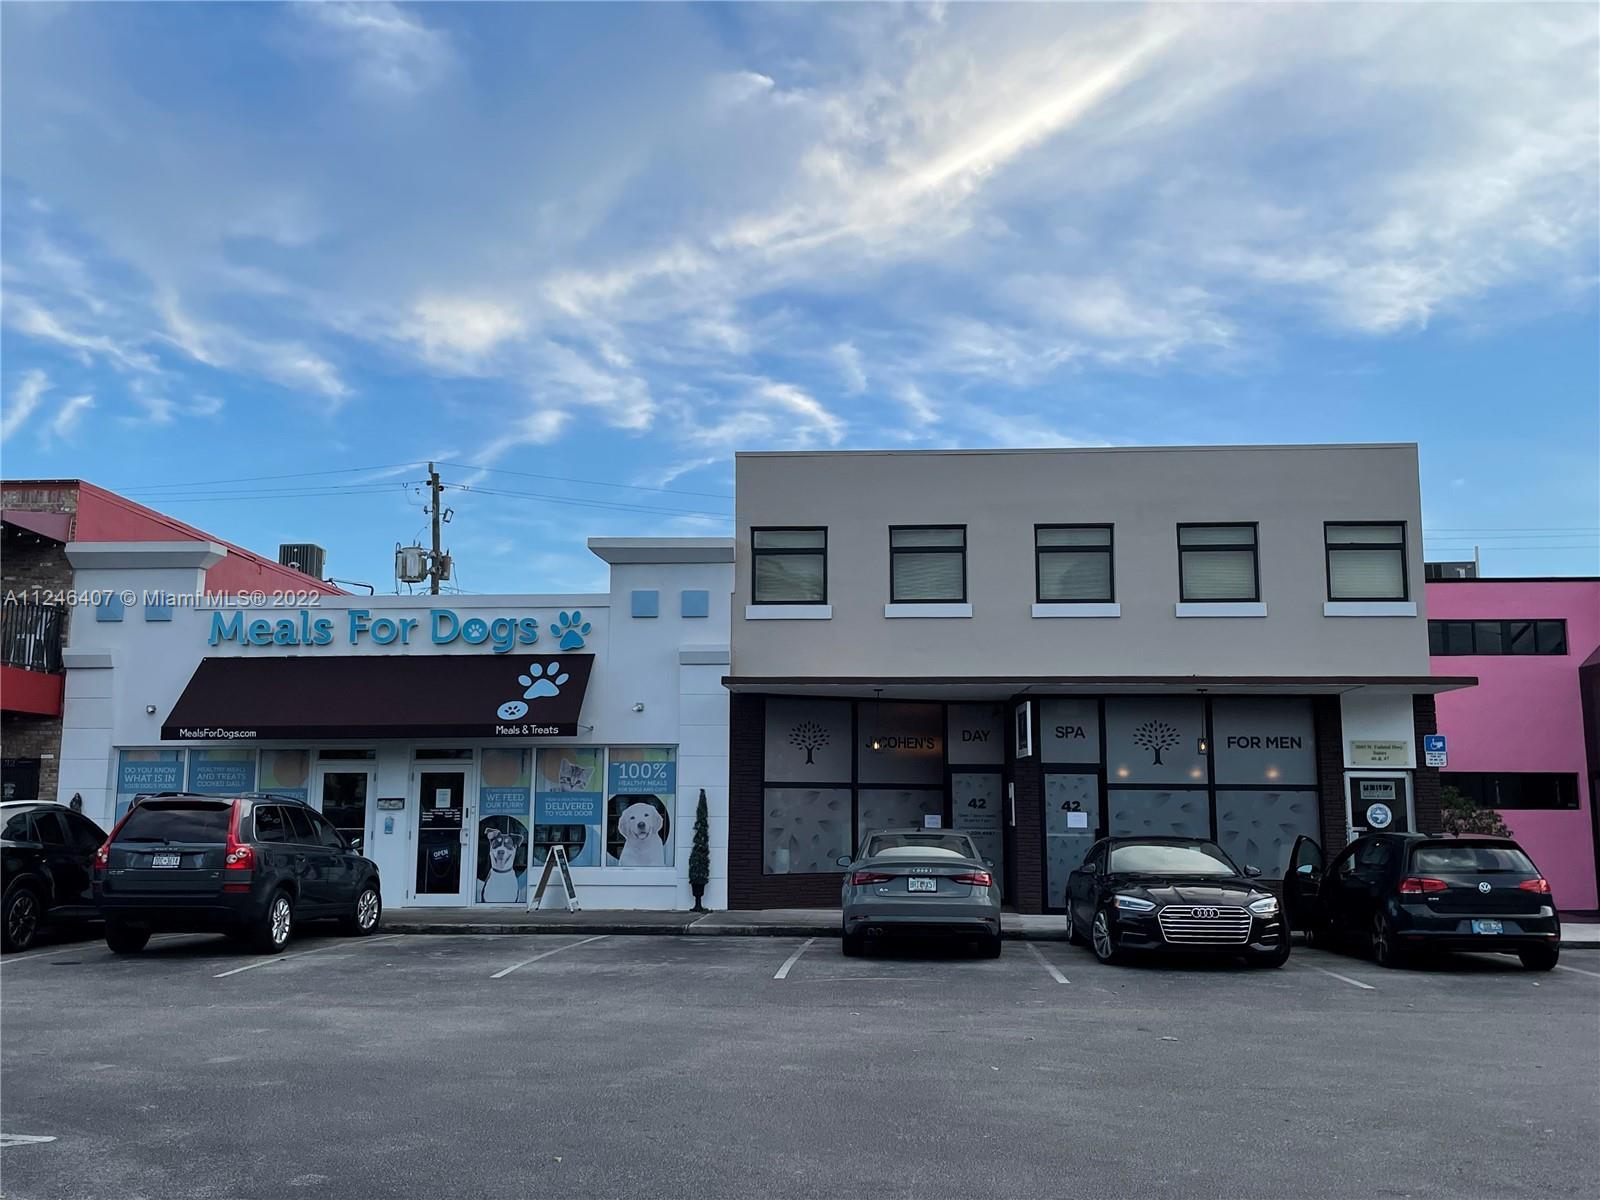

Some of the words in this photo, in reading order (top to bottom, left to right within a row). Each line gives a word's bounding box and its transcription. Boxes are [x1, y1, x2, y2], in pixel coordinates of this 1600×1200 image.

[208, 610, 334, 646] Meals
[348, 609, 419, 645] For
[430, 609, 539, 653] Dogs
[179, 728, 257, 739] MealsForDogs.com
[495, 725, 521, 735] Meals
[522, 724, 529, 734] &
[530, 724, 559, 734] Treats
[1055, 726, 1086, 739] SPA
[962, 730, 991, 742] DAY
[1227, 736, 1261, 749] FOR
[1265, 736, 1302, 749] MEN
[619, 763, 667, 779] 100%
[124, 774, 152, 783] WHAT
[153, 774, 163, 782] IS
[165, 774, 175, 782] IN
[197, 773, 214, 781] AND
[216, 773, 247, 781] TREATS
[486, 793, 501, 802] WE
[503, 793, 525, 802] FEED
[545, 802, 594, 810] DELIVERED
[967, 798, 987, 809] 42
[1060, 800, 1082, 812] 42
